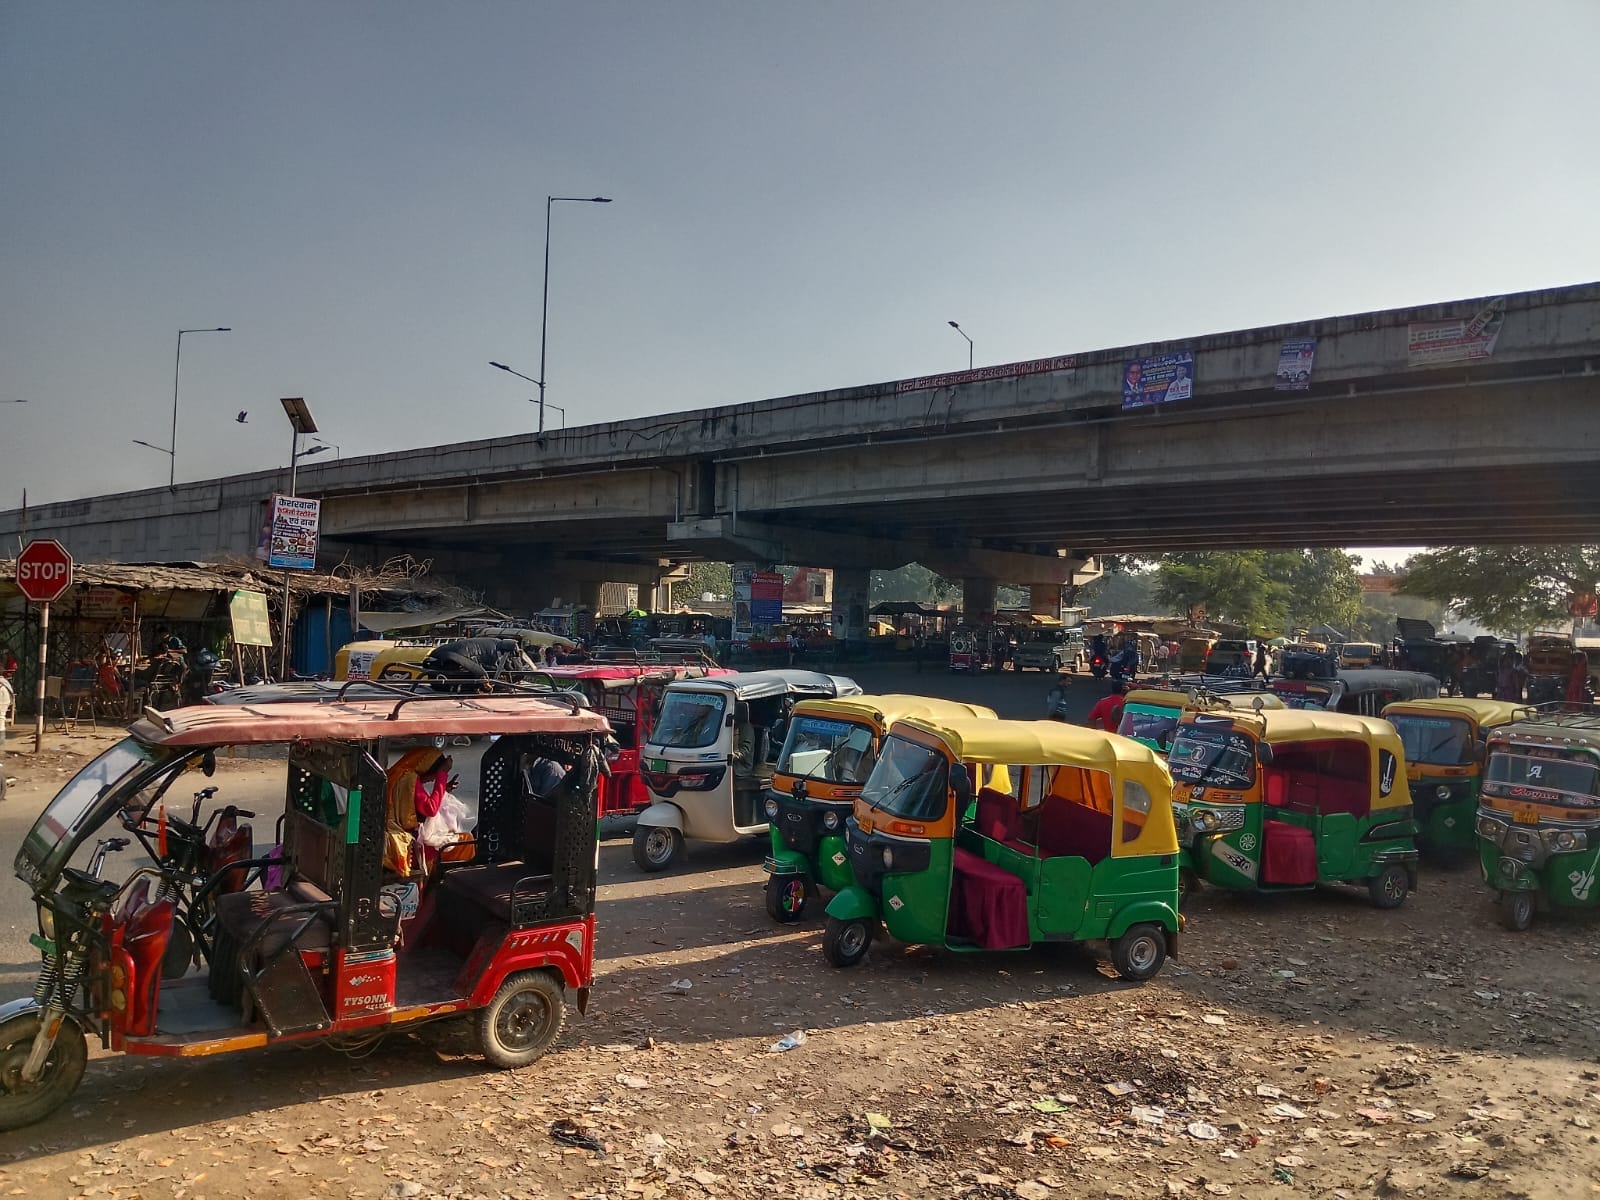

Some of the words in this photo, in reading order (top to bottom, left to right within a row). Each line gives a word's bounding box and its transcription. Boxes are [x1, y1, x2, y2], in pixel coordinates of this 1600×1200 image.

[20, 562, 66, 580] STOP
[1526, 765, 1543, 778] A
[344, 994, 387, 1006] TYSONN
